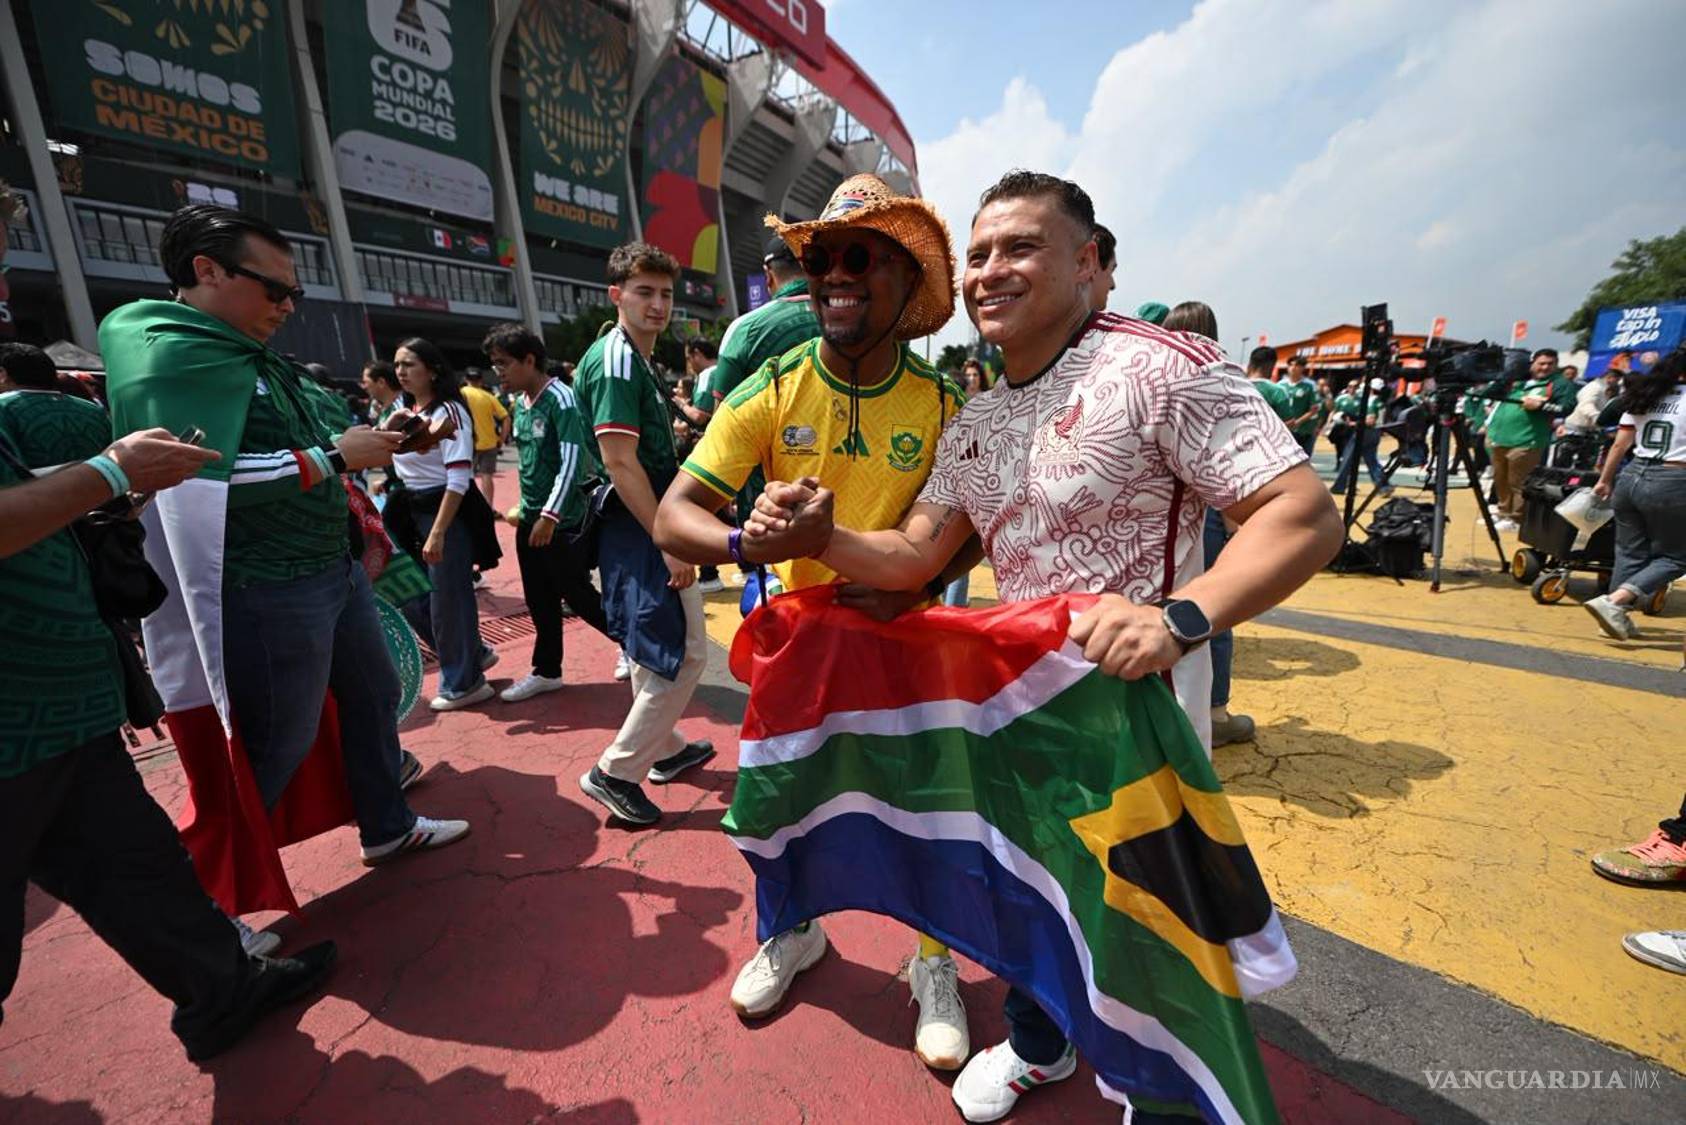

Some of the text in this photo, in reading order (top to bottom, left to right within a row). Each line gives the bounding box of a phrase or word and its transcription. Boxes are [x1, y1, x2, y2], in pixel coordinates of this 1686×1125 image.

[394, 28, 431, 56] FIFA
[84, 38, 262, 114] SOMOS
[370, 54, 454, 105] COPA
[91, 78, 266, 142] CIUDAD DE
[371, 80, 456, 120] MUNDIAL
[373, 99, 457, 141] 2026
[533, 171, 618, 215] WE ARE
[533, 196, 618, 230] MEXICO CITY
[1623, 306, 1657, 320] VISA
[1641, 420, 1675, 462] 9
